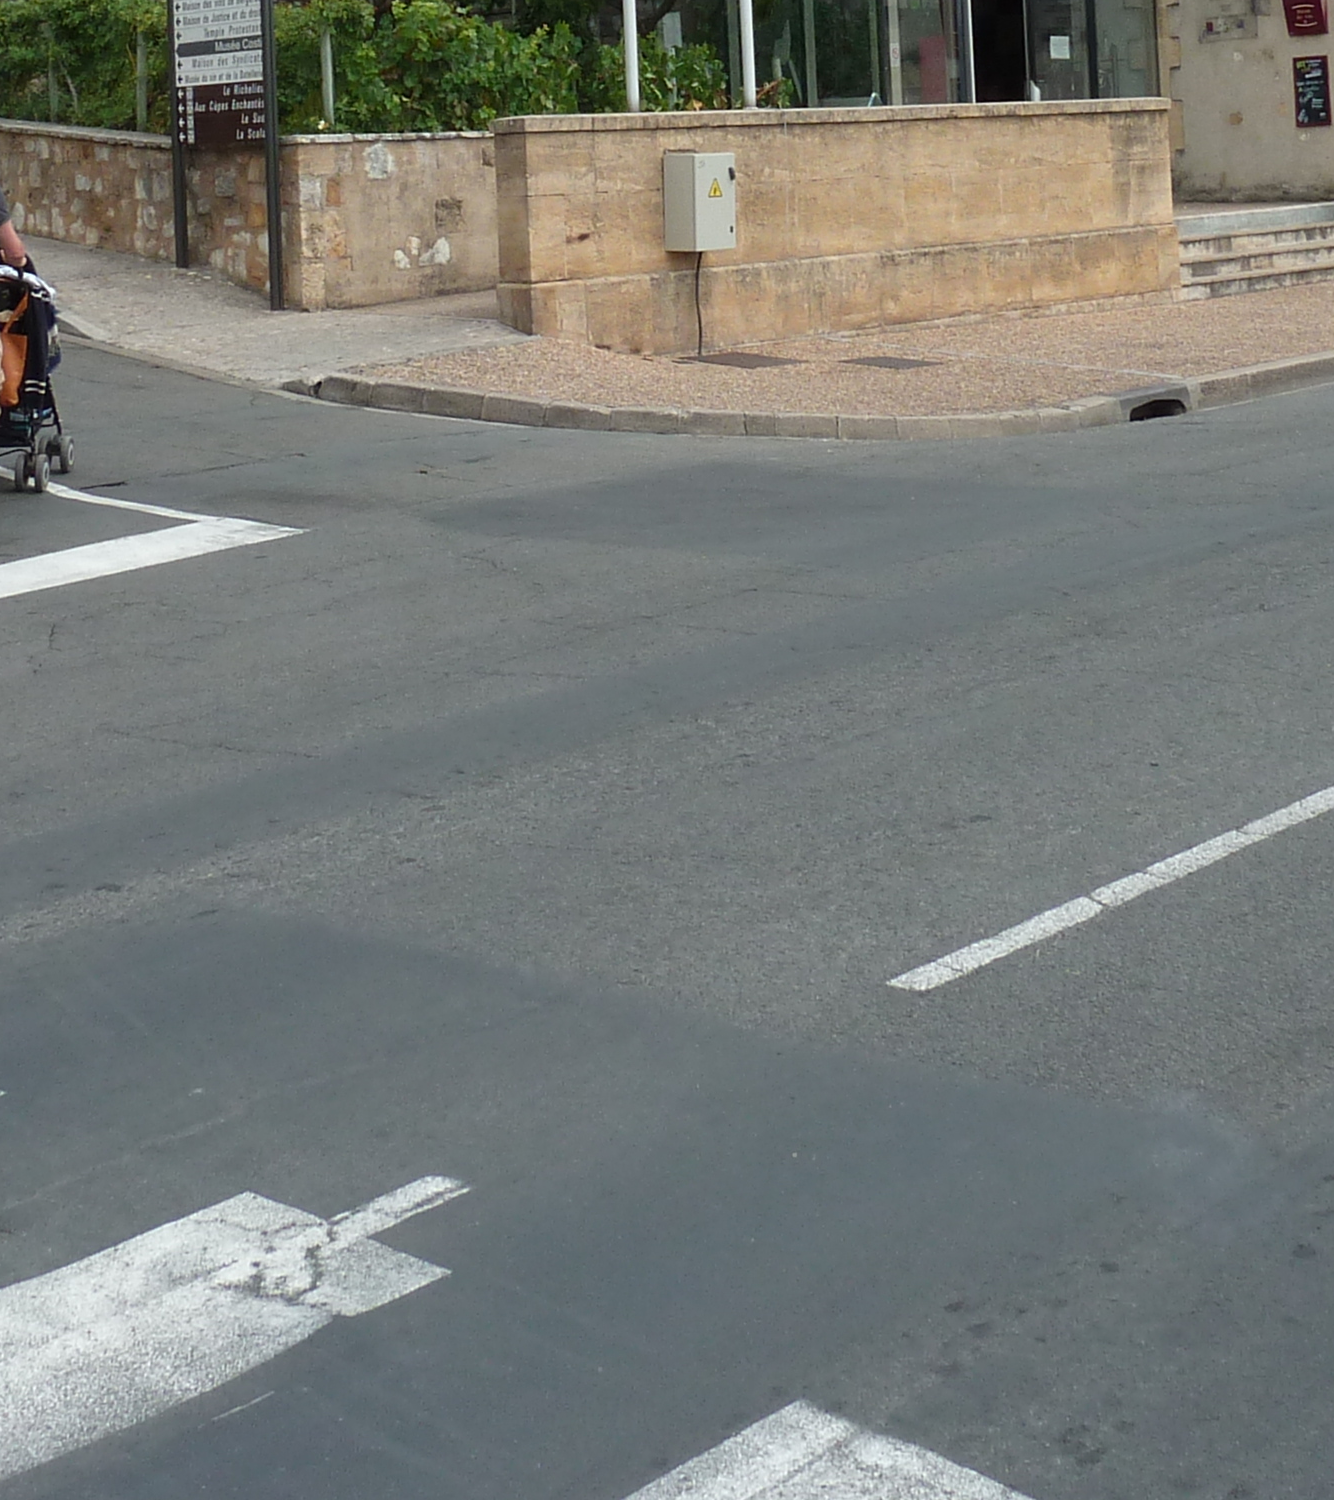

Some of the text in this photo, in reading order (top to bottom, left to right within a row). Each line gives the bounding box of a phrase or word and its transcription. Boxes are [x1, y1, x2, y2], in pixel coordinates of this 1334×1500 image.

[228, 24, 259, 36] Protestan
[232, 53, 260, 67] Syndicat
[223, 85, 231, 96] Le
[241, 113, 249, 124] Le
[236, 129, 244, 140] La
